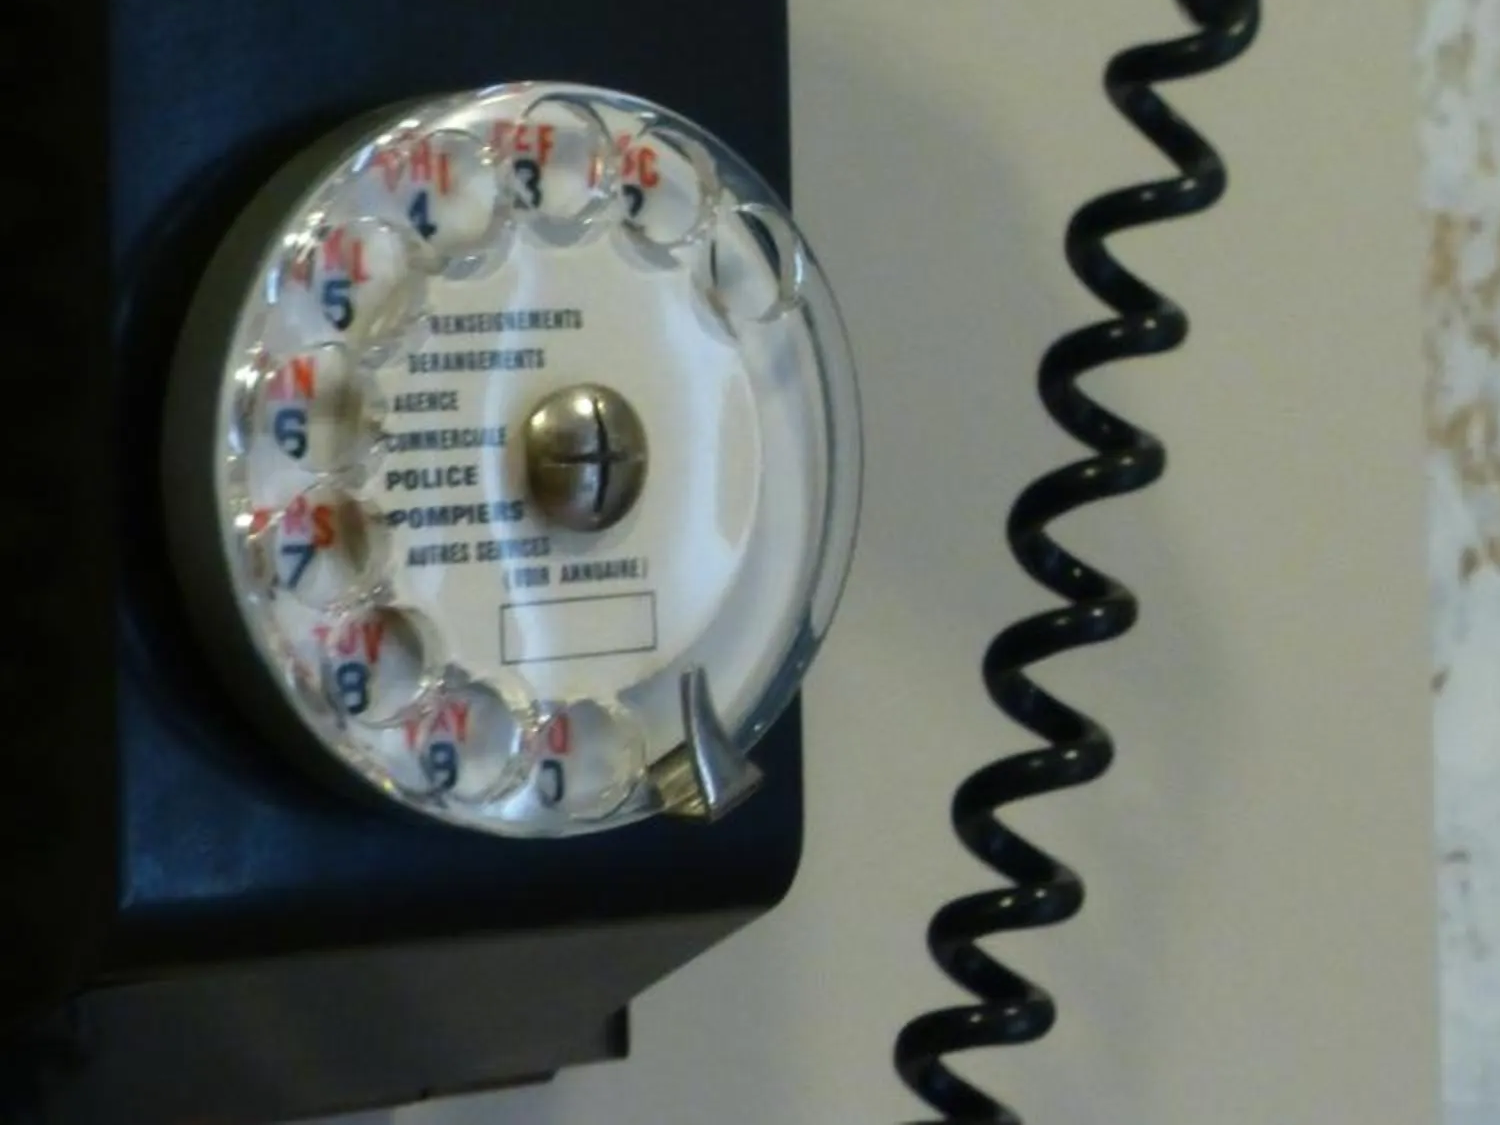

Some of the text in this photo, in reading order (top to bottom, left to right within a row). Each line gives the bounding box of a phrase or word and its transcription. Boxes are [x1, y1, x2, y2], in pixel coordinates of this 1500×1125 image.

[321, 278, 355, 332] 5
[393, 391, 459, 412] AGENCE
[273, 407, 308, 460] 6
[385, 466, 478, 490] POLICE
[386, 500, 525, 528] POMPIERS
[280, 543, 316, 588] 7
[407, 536, 552, 567] AUTRES SERVICES
[338, 661, 370, 715] 8
